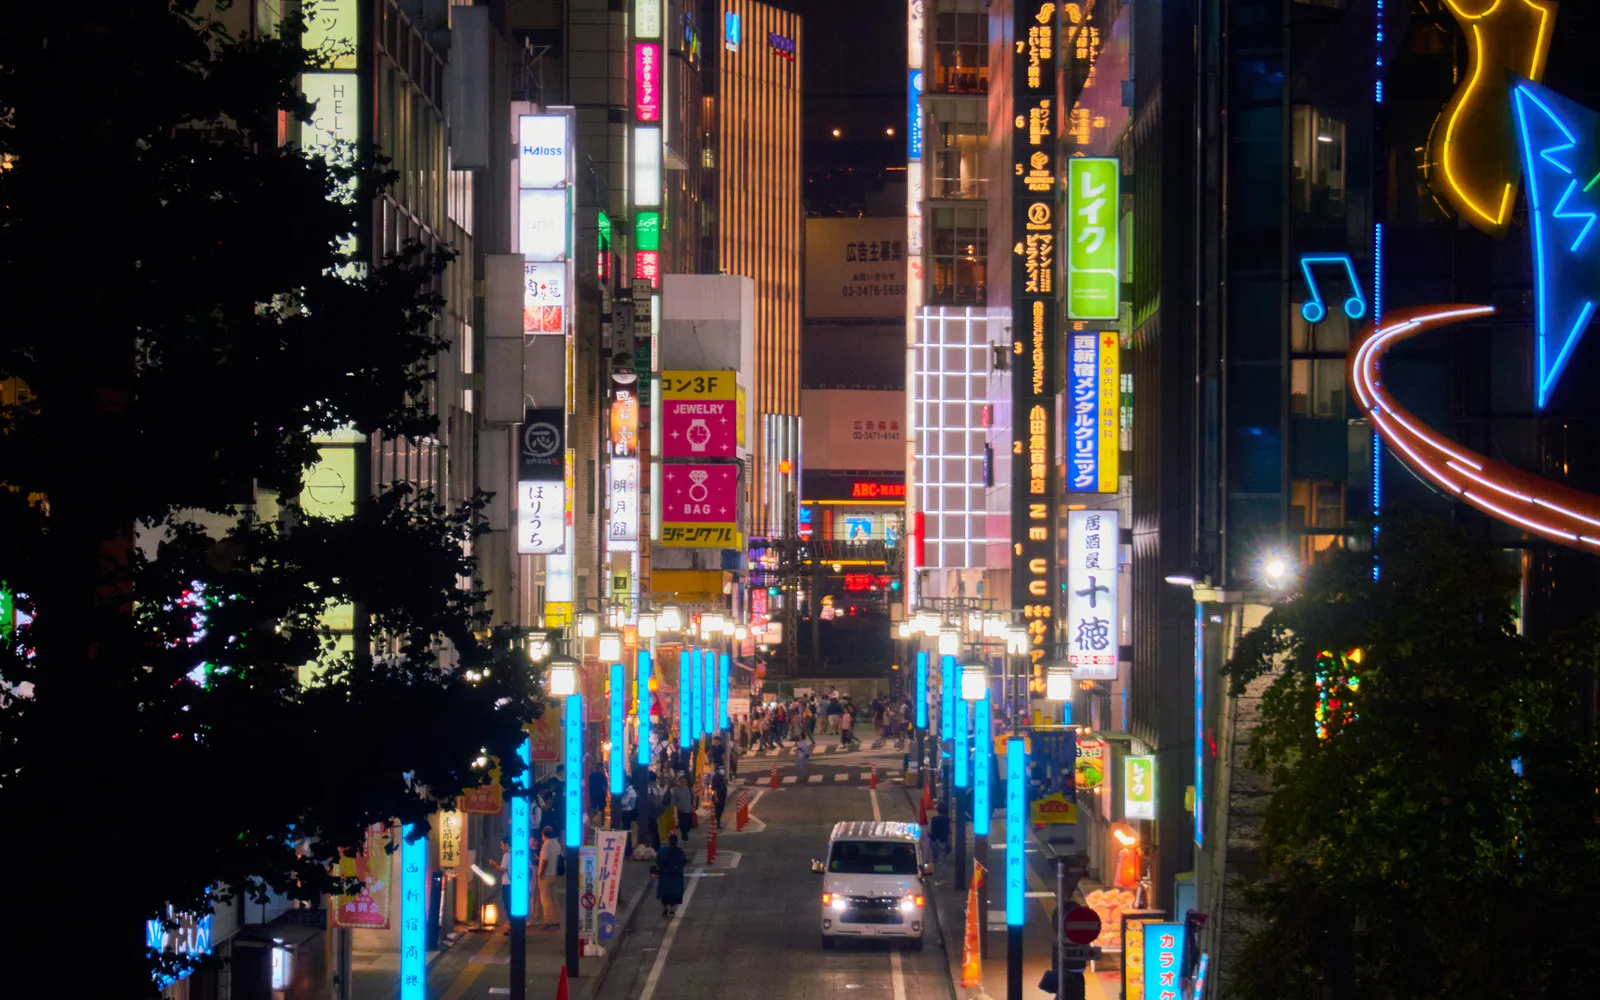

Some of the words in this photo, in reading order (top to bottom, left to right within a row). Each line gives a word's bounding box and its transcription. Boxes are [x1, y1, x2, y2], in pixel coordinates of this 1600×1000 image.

[1016, 41, 1025, 54] 7
[1028, 26, 1040, 88] さいとう眼科
[1039, 26, 1051, 59] 西新宿
[1015, 115, 1025, 128] 6
[1015, 163, 1024, 175] 5
[1078, 171, 1107, 254] レイク
[846, 241, 902, 262] 広告主募集
[1014, 242, 1024, 255] 4
[1025, 233, 1039, 292] ピラティス
[1039, 234, 1053, 268] マシン
[1013, 341, 1023, 355] 3
[672, 404, 724, 415] JEWELRY
[853, 420, 899, 431] 広告募集
[1074, 335, 1096, 488] 西新宿メンタルクリニック
[1013, 440, 1022, 454] 2
[529, 486, 544, 547] ほりうち
[613, 480, 627, 536] 明月館
[683, 503, 711, 514] BAG
[662, 528, 732, 542] ジャングル
[1085, 514, 1100, 569] 居酒屋
[1075, 575, 1110, 651] 十徳
[1131, 761, 1145, 796] レイク
[442, 816, 455, 861] 季節料理
[598, 837, 616, 910] エールーム
